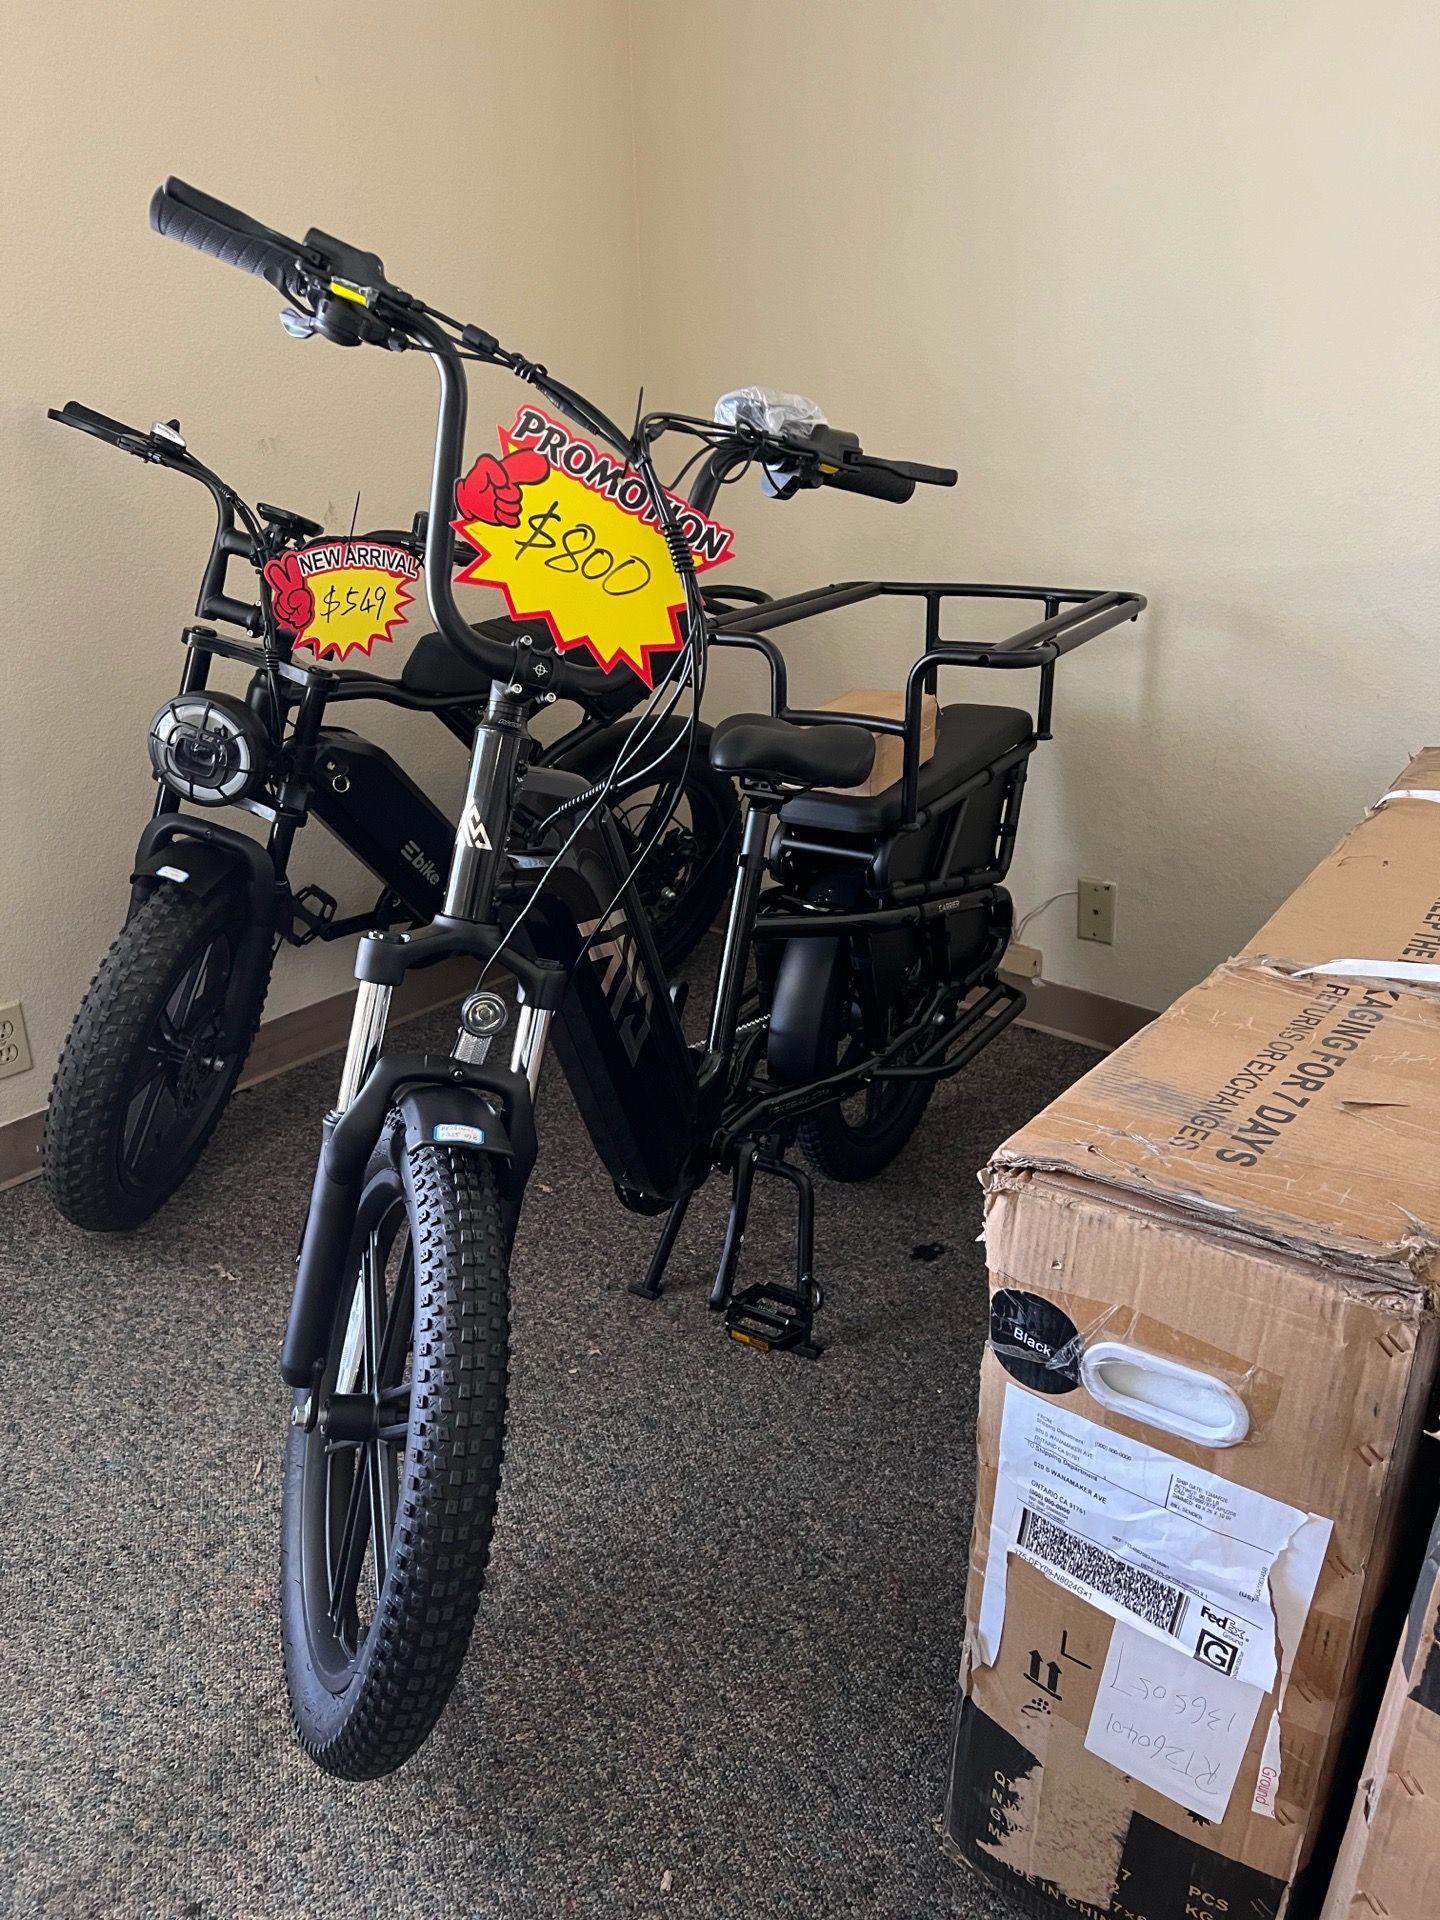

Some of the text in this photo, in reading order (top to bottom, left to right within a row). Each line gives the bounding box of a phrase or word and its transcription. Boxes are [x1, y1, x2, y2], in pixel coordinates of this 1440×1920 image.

[512, 409, 729, 561] PROMOON
[298, 547, 416, 577] NEW ARRIVAL
[514, 500, 651, 596] $800
[320, 585, 387, 624] $549
[1168, 983, 1351, 1150] RETURNS OR EXCHANGES
[1281, 1050, 1347, 1092] FOR
[1272, 1091, 1311, 1108] 7
[1216, 1104, 1297, 1167] DAYS
[1013, 1327, 1051, 1357] Black
[1035, 1445, 1062, 1464] Shipping
[1063, 1458, 1098, 1482] Department
[1031, 1480, 1058, 1500] ONTARIO
[1059, 1496, 1069, 1507] CA
[1051, 1470, 1093, 1497] WANAMAKER
[1093, 1492, 1107, 1505] AVE
[1200, 1605, 1246, 1640] FedEx
[1222, 1631, 1244, 1647] Ground
[1203, 1640, 1230, 1668] G
[1256, 1766, 1277, 1807] Ground
[1041, 1882, 1060, 1899] IN
[1189, 1885, 1229, 1912] PCS
